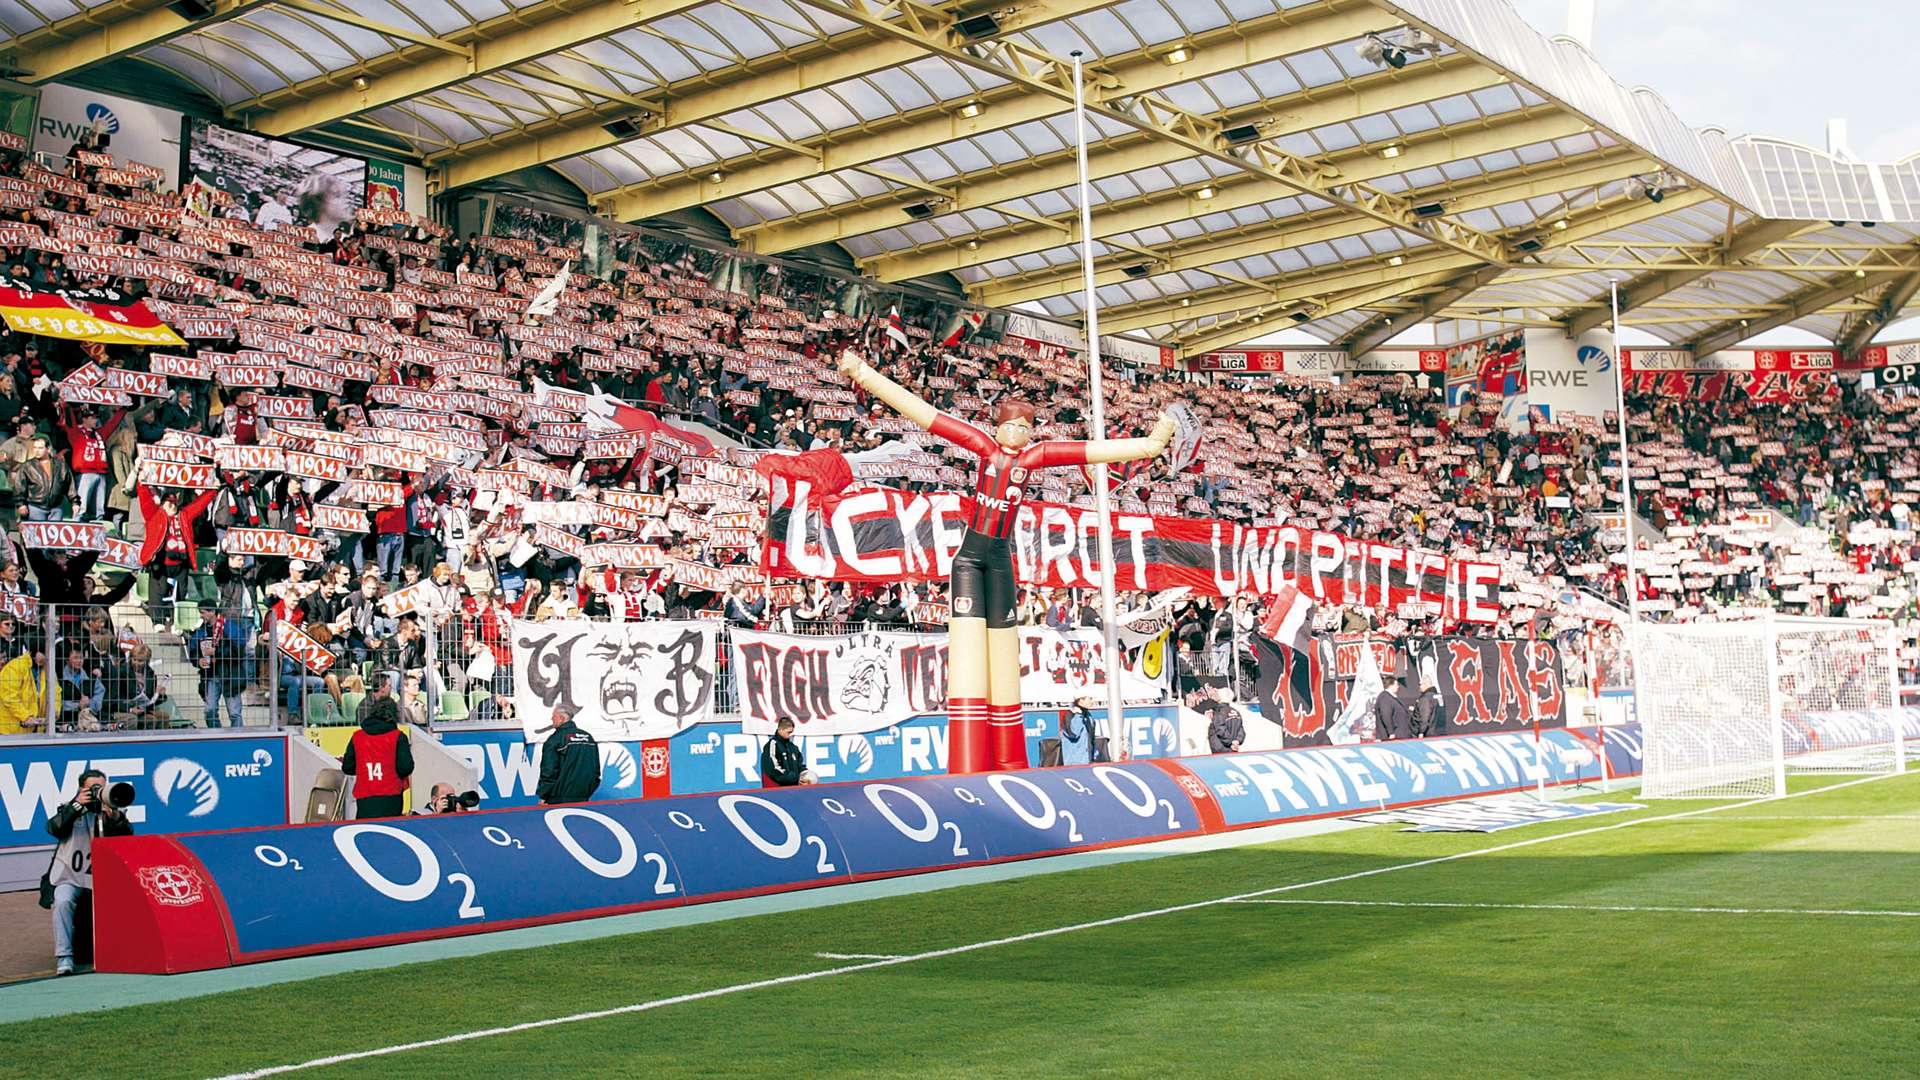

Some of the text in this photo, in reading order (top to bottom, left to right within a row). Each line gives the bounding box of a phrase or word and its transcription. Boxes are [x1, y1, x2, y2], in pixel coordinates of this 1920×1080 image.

[37, 174, 65, 191] 1904
[109, 171, 133, 185] 1904
[380, 168, 403, 182] Jahre
[8, 180, 35, 193] 1904
[10, 194, 33, 207] 1904
[111, 212, 137, 226] 1904
[40, 238, 71, 253] 1904
[169, 245, 200, 259] 1904
[262, 245, 284, 257] 1904
[408, 244, 430, 257] 1904
[77, 256, 108, 272] 1904
[133, 262, 160, 276] 1904
[272, 282, 298, 295] 1904
[450, 293, 473, 305] 1904
[285, 309, 311, 324] 1904
[318, 308, 341, 326] 1904
[347, 302, 369, 316] 1904
[194, 322, 222, 335] 1904
[1020, 319, 1040, 338] EVL
[275, 341, 303, 359] 1904
[304, 337, 331, 352] 1904
[471, 343, 493, 355] 1904
[589, 356, 610, 370] 1904
[614, 352, 633, 366] 1904
[1220, 360, 1246, 370] LIGA
[1320, 353, 1351, 369] EVL
[1660, 352, 1691, 368] EVL
[1810, 359, 1832, 368] LIGA
[164, 359, 198, 376] 1904
[231, 367, 265, 384] 1904
[333, 362, 363, 378] 1904
[120, 373, 157, 395] 1904
[295, 370, 322, 388] 1904
[471, 374, 496, 389] 1904
[1530, 370, 1589, 387] RWE
[76, 387, 115, 404] 1904
[412, 397, 443, 410] 1904
[554, 395, 577, 409] 1904
[270, 399, 304, 417] 1904
[406, 414, 438, 431] 1904
[448, 431, 476, 447] 1904
[550, 424, 577, 438] 1904
[413, 440, 446, 457] 1904
[547, 440, 570, 454] 1904
[597, 441, 625, 456] 1904
[235, 449, 271, 467] 1904
[380, 447, 413, 468] 1904
[159, 464, 205, 486] 1904
[300, 457, 336, 477] 1904
[868, 465, 891, 476] 1904
[363, 482, 392, 500] 1904
[493, 475, 519, 491] 1904
[618, 496, 652, 512] 1904
[977, 493, 1010, 512] RWE
[328, 509, 358, 527] 1904
[599, 508, 627, 527] 1904
[40, 526, 91, 547] 1904
[240, 531, 278, 552] 1904
[550, 529, 574, 551] 1904
[721, 532, 746, 546] 1904
[622, 548, 650, 567] 1904
[686, 566, 713, 588] 1904
[279, 632, 329, 672] 1904
[874, 735, 895, 746] RWE
[690, 743, 714, 755] RWE
[226, 763, 261, 778] RWE
[366, 762, 383, 781] 14
[447, 743, 543, 799] RW
[1227, 748, 1391, 813] RWE
[1215, 783, 1249, 798] RWE
